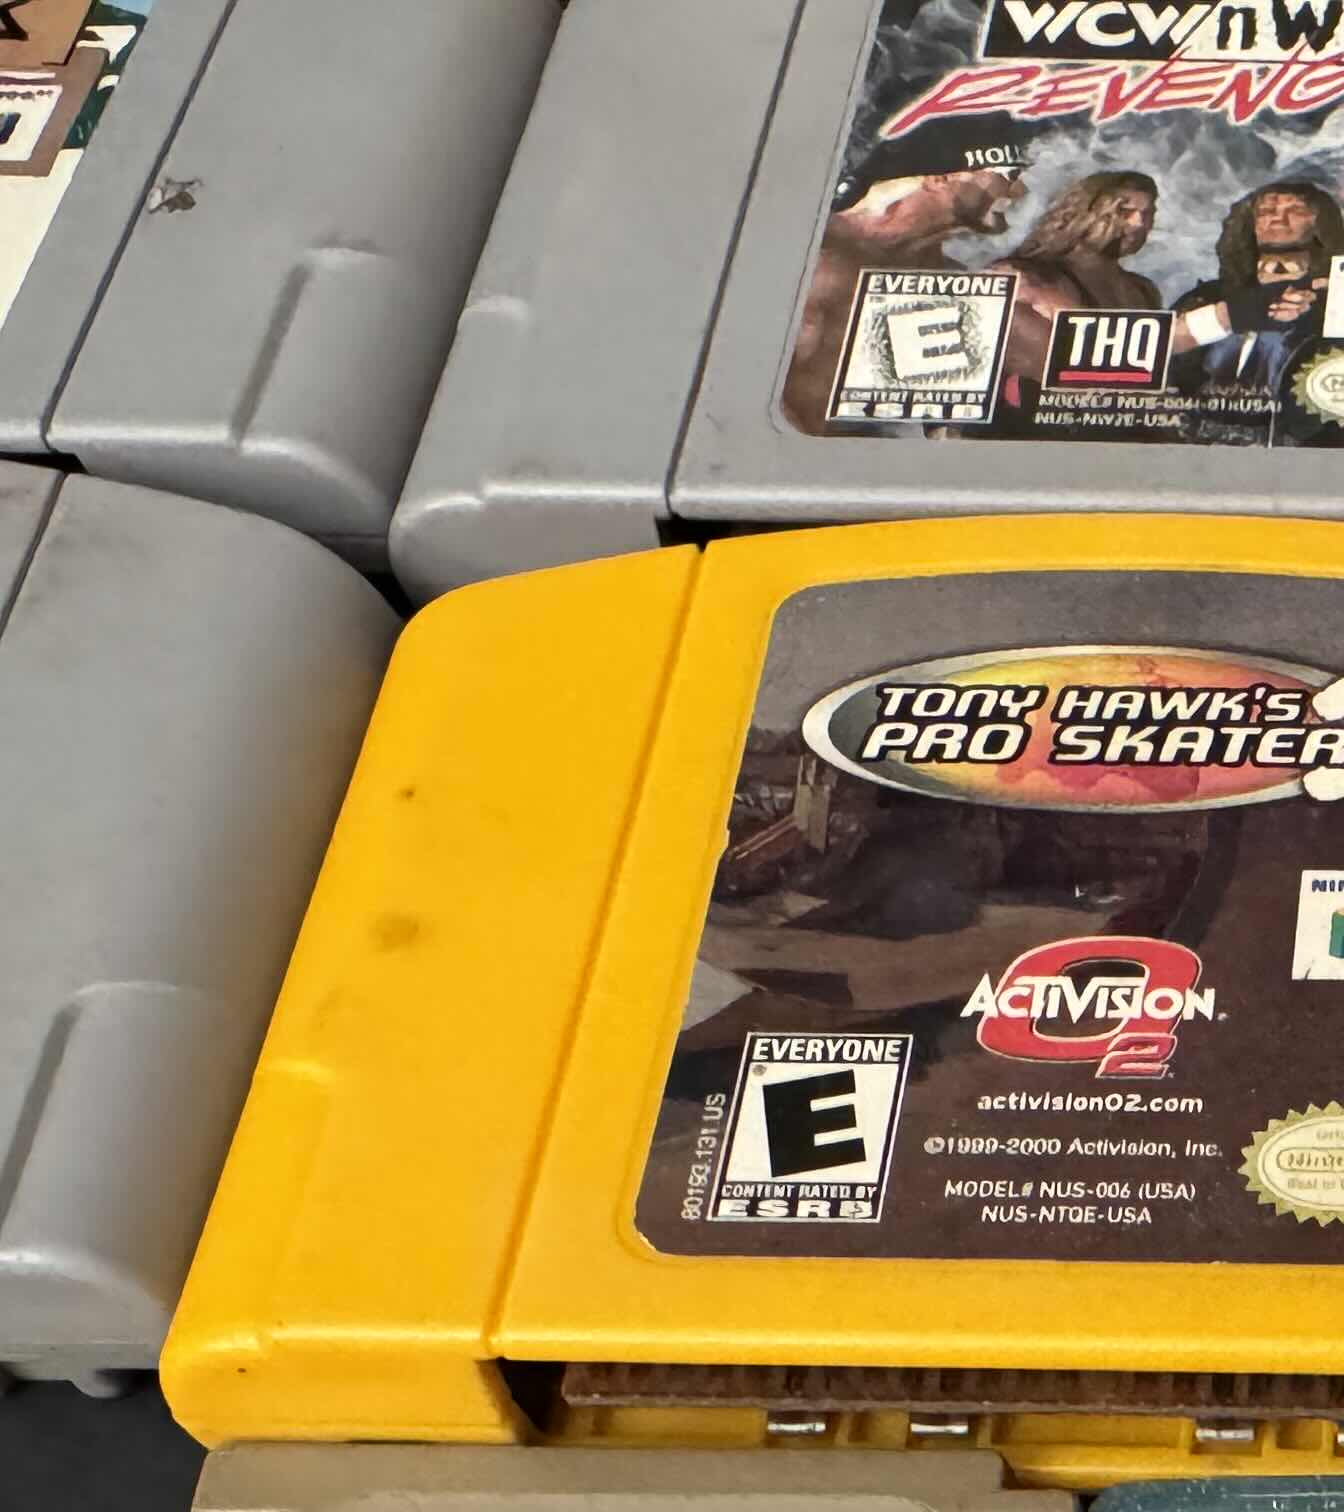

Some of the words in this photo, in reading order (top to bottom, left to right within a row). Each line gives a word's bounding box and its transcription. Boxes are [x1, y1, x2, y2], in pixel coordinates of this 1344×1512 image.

[868, 274, 1009, 297] EVERYONE
[1067, 315, 1161, 374] THQ
[881, 684, 1041, 722] TONY
[1051, 684, 1304, 723] HAWK'S
[860, 720, 1018, 763] PRO
[751, 1037, 904, 1063] EVERYONE
[763, 1068, 868, 1179] E
[1184, 1138, 1224, 1158] Inc.
[720, 1183, 796, 1199] CONTENT
[798, 1184, 851, 1200] RATED
[855, 1185, 878, 1200] BY
[1039, 1181, 1132, 1200] NUS-006
[1138, 1181, 1197, 1202] (USA)
[716, 1199, 874, 1220] ESRB
